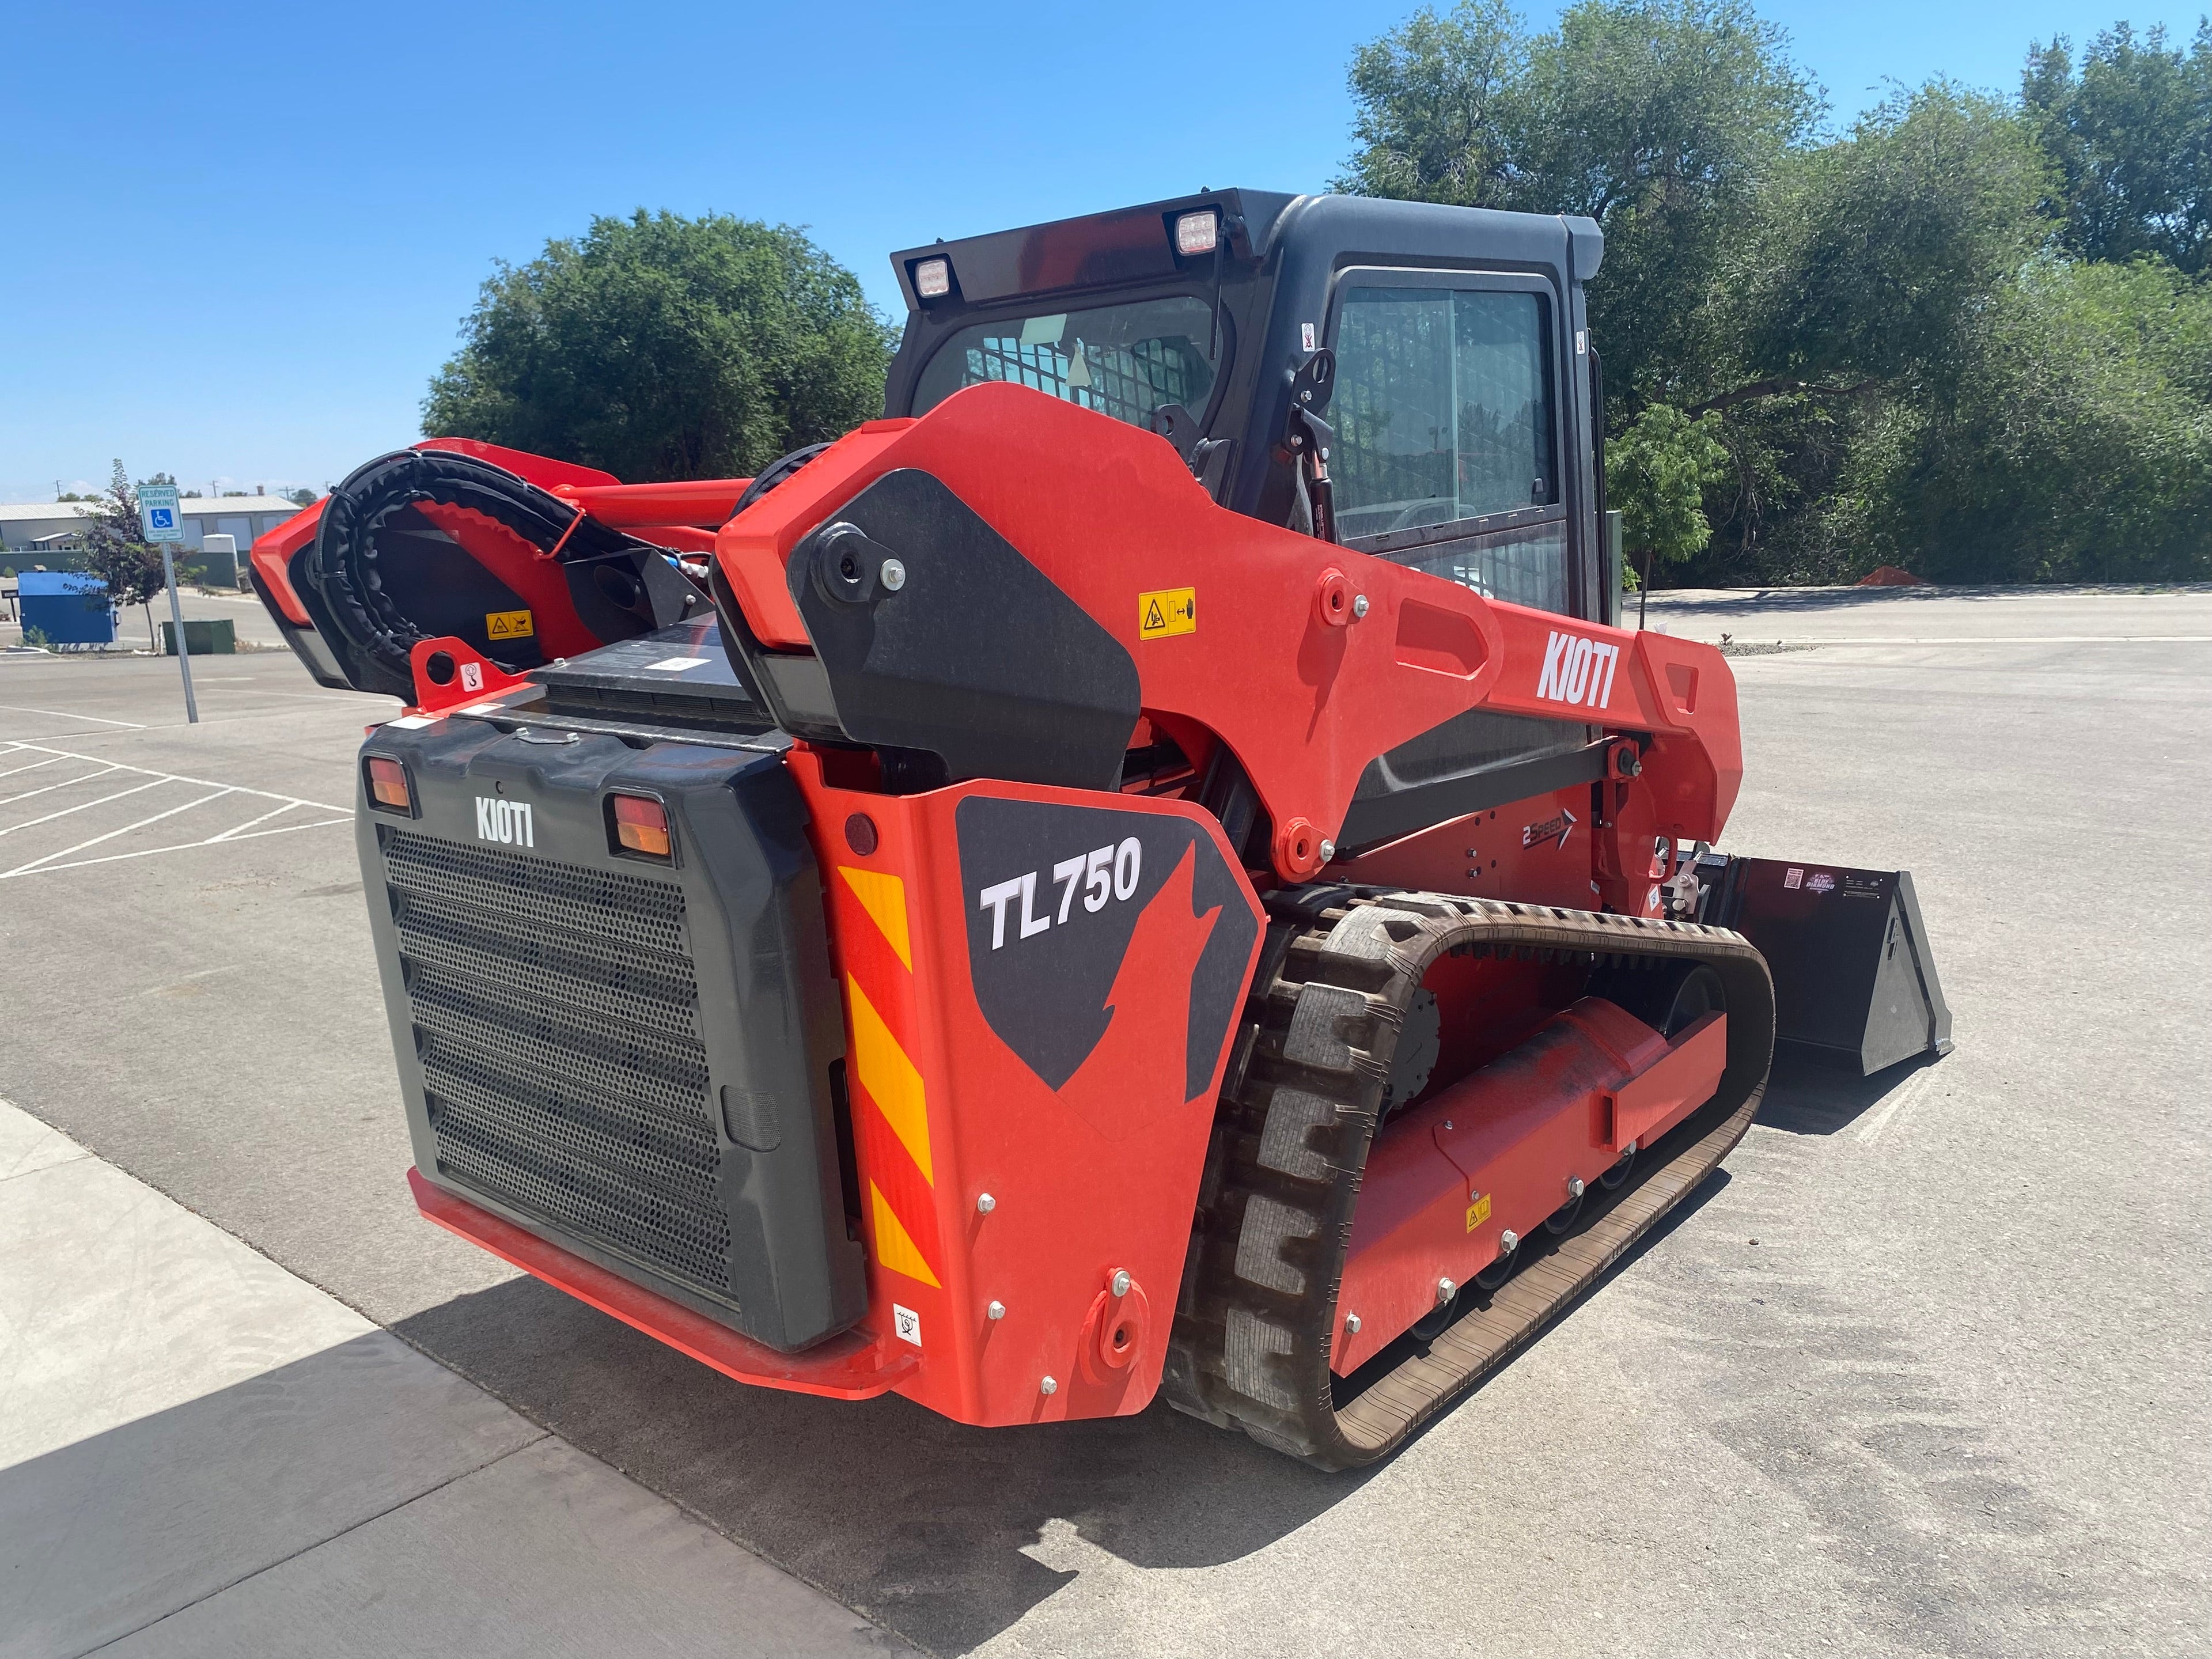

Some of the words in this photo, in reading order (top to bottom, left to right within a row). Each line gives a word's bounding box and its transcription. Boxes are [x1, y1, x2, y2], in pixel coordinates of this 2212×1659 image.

[141, 490, 175, 498] RESERVED
[145, 499, 174, 507] PARKING
[1536, 631, 1619, 709] KIOTI
[475, 796, 534, 847] KIOTI
[1806, 881, 1835, 889] DIAMOND
